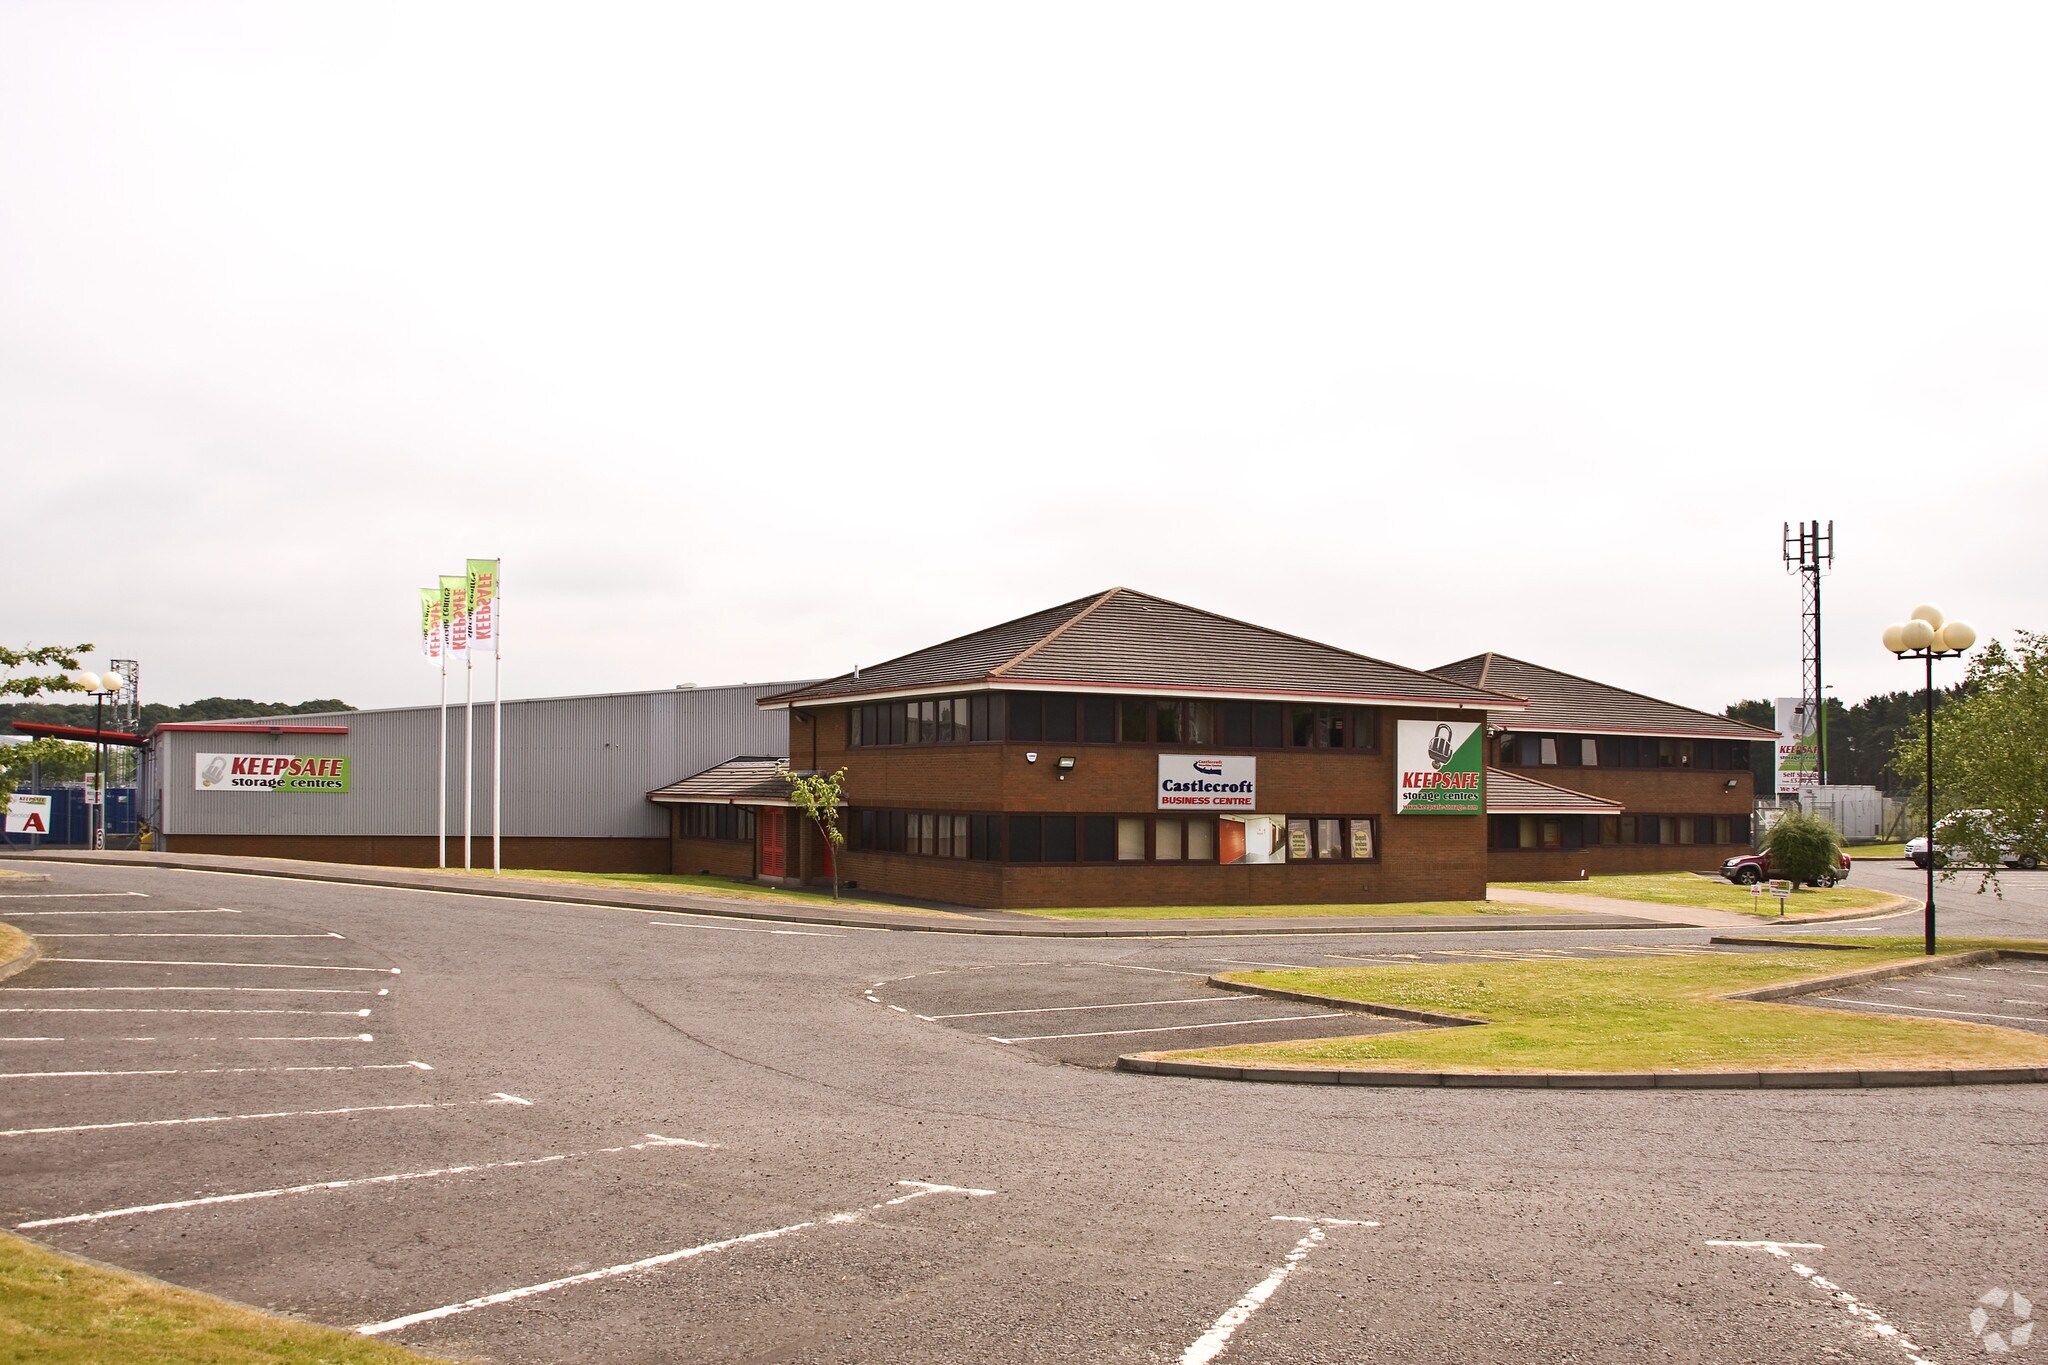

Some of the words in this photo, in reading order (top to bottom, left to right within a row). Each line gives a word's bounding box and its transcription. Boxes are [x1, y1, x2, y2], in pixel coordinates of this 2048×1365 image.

[1779, 745, 1819, 754] KEEPSAF
[231, 756, 344, 777] KEEPSAFE
[231, 778, 285, 789] storage
[290, 779, 342, 788] centres
[1162, 779, 1253, 793] Castlecroft
[1402, 772, 1479, 789] KEEPSAFE
[1162, 796, 1210, 805] BUSINESS
[1213, 797, 1252, 805] CENTRE
[1402, 792, 1440, 801] storage
[1443, 792, 1479, 800] centres
[22, 812, 46, 832] A
